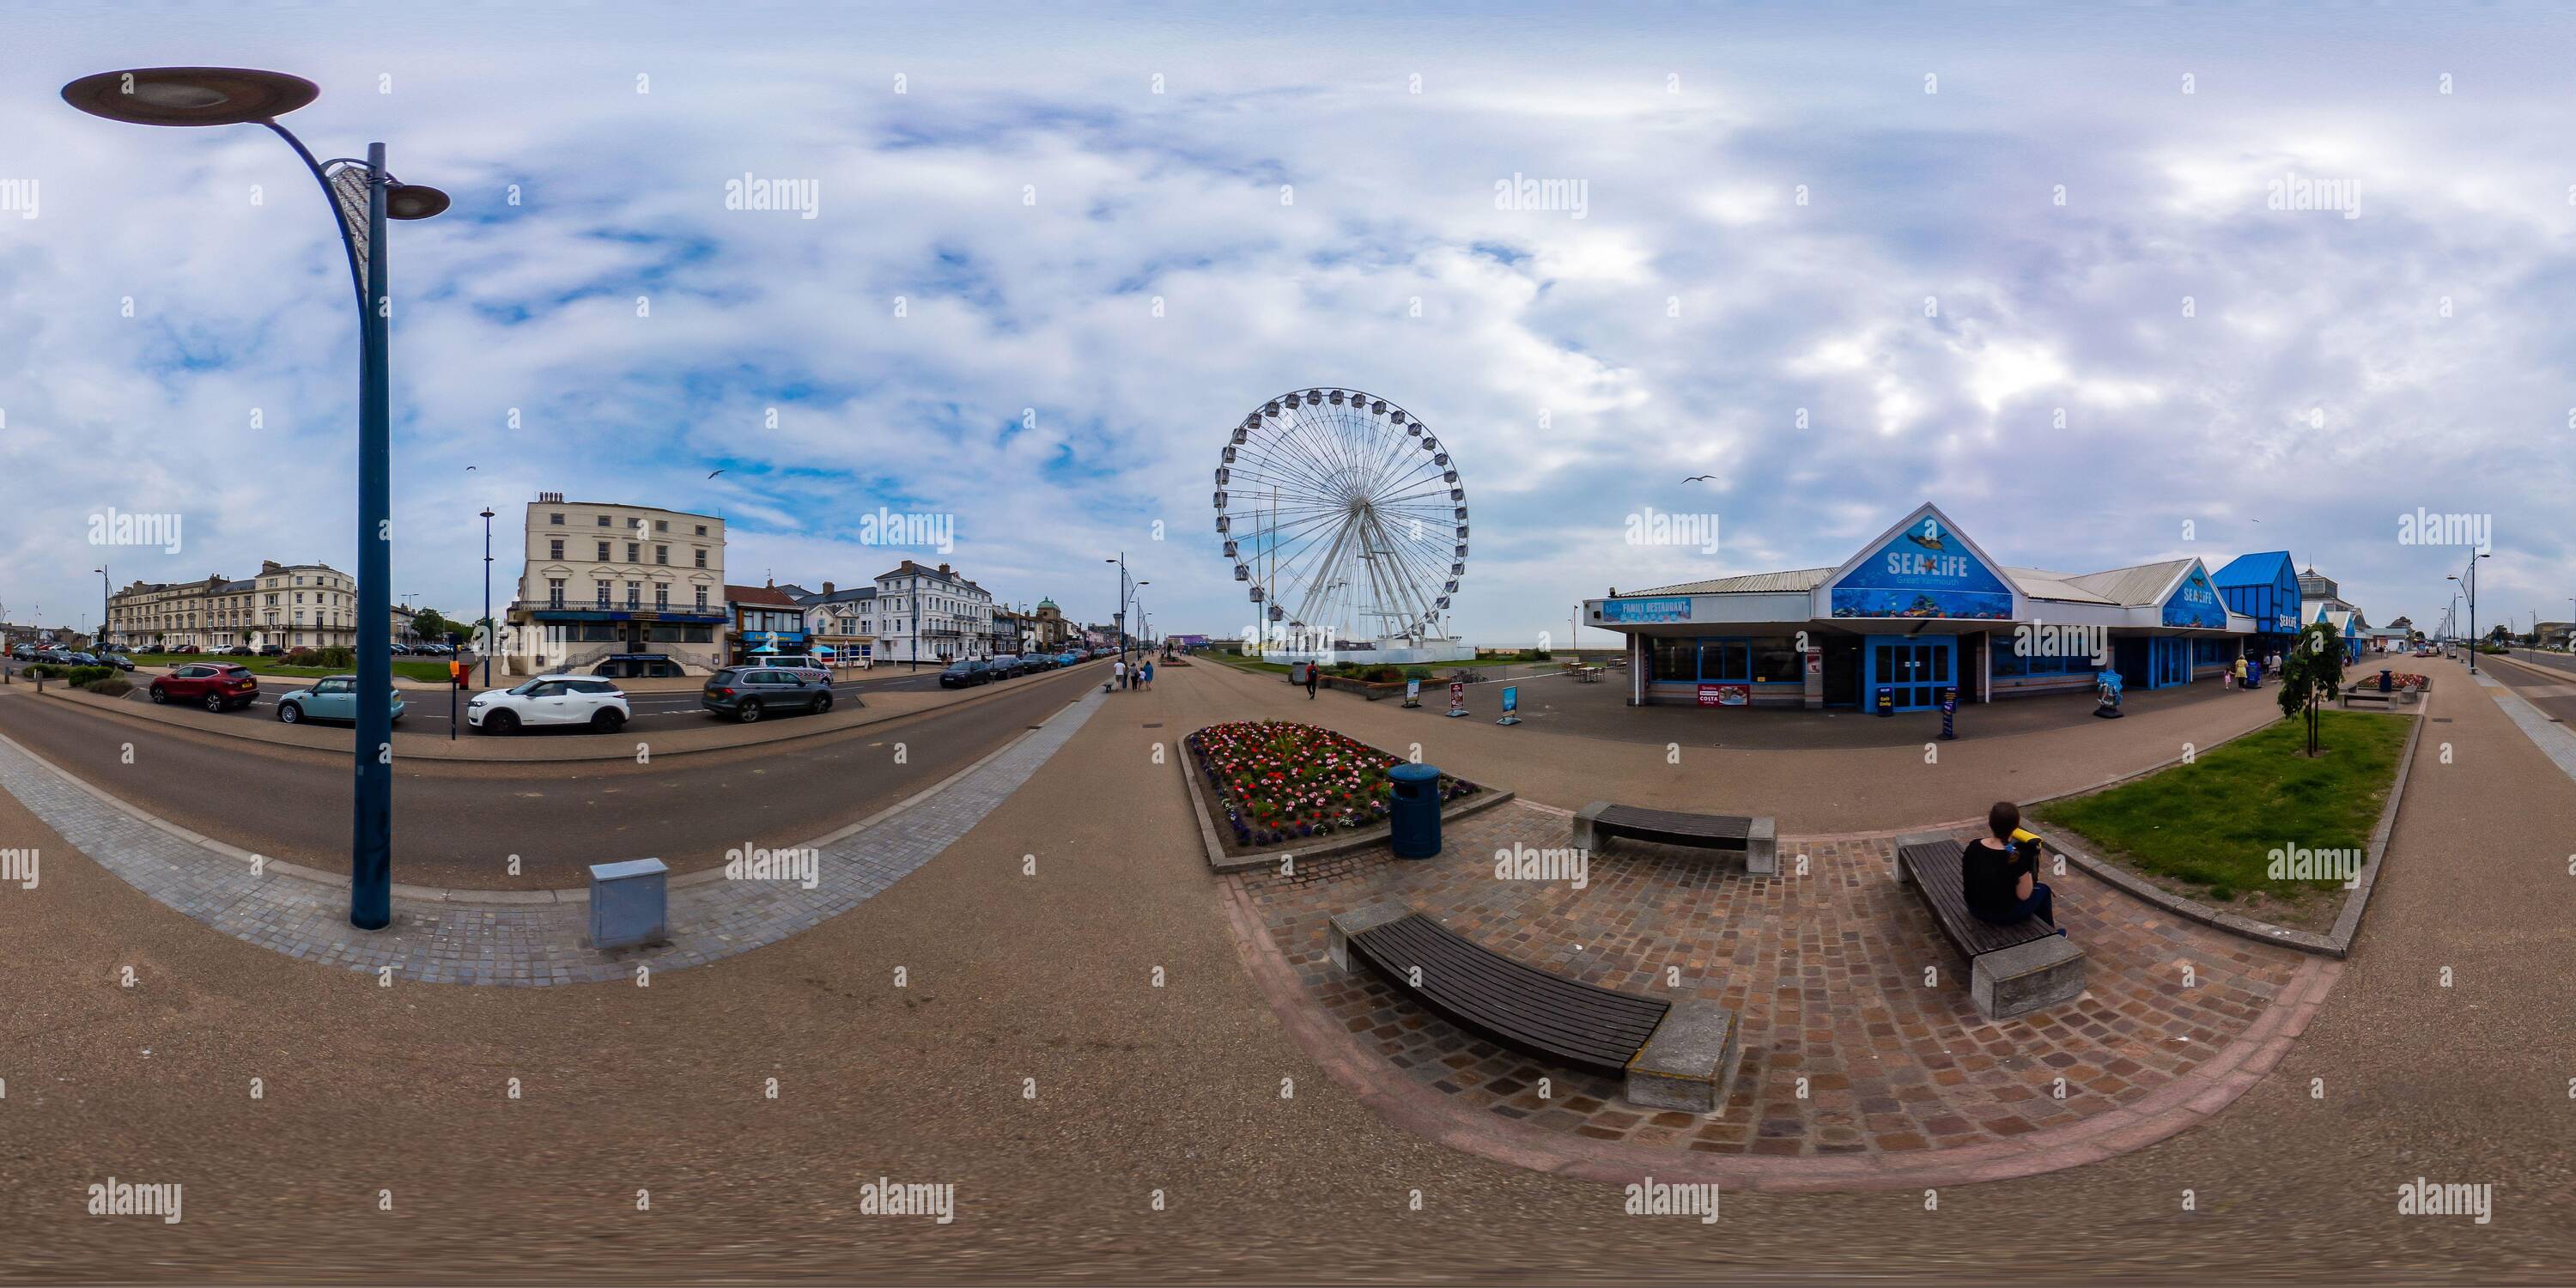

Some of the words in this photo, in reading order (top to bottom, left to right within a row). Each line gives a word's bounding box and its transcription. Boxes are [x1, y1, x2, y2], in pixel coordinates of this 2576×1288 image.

[1887, 552, 1926, 574] SEA
[2184, 587, 2198, 602] SEA
[1623, 603, 1644, 613] FAMILY
[1647, 602, 1686, 612] RESTAURANT
